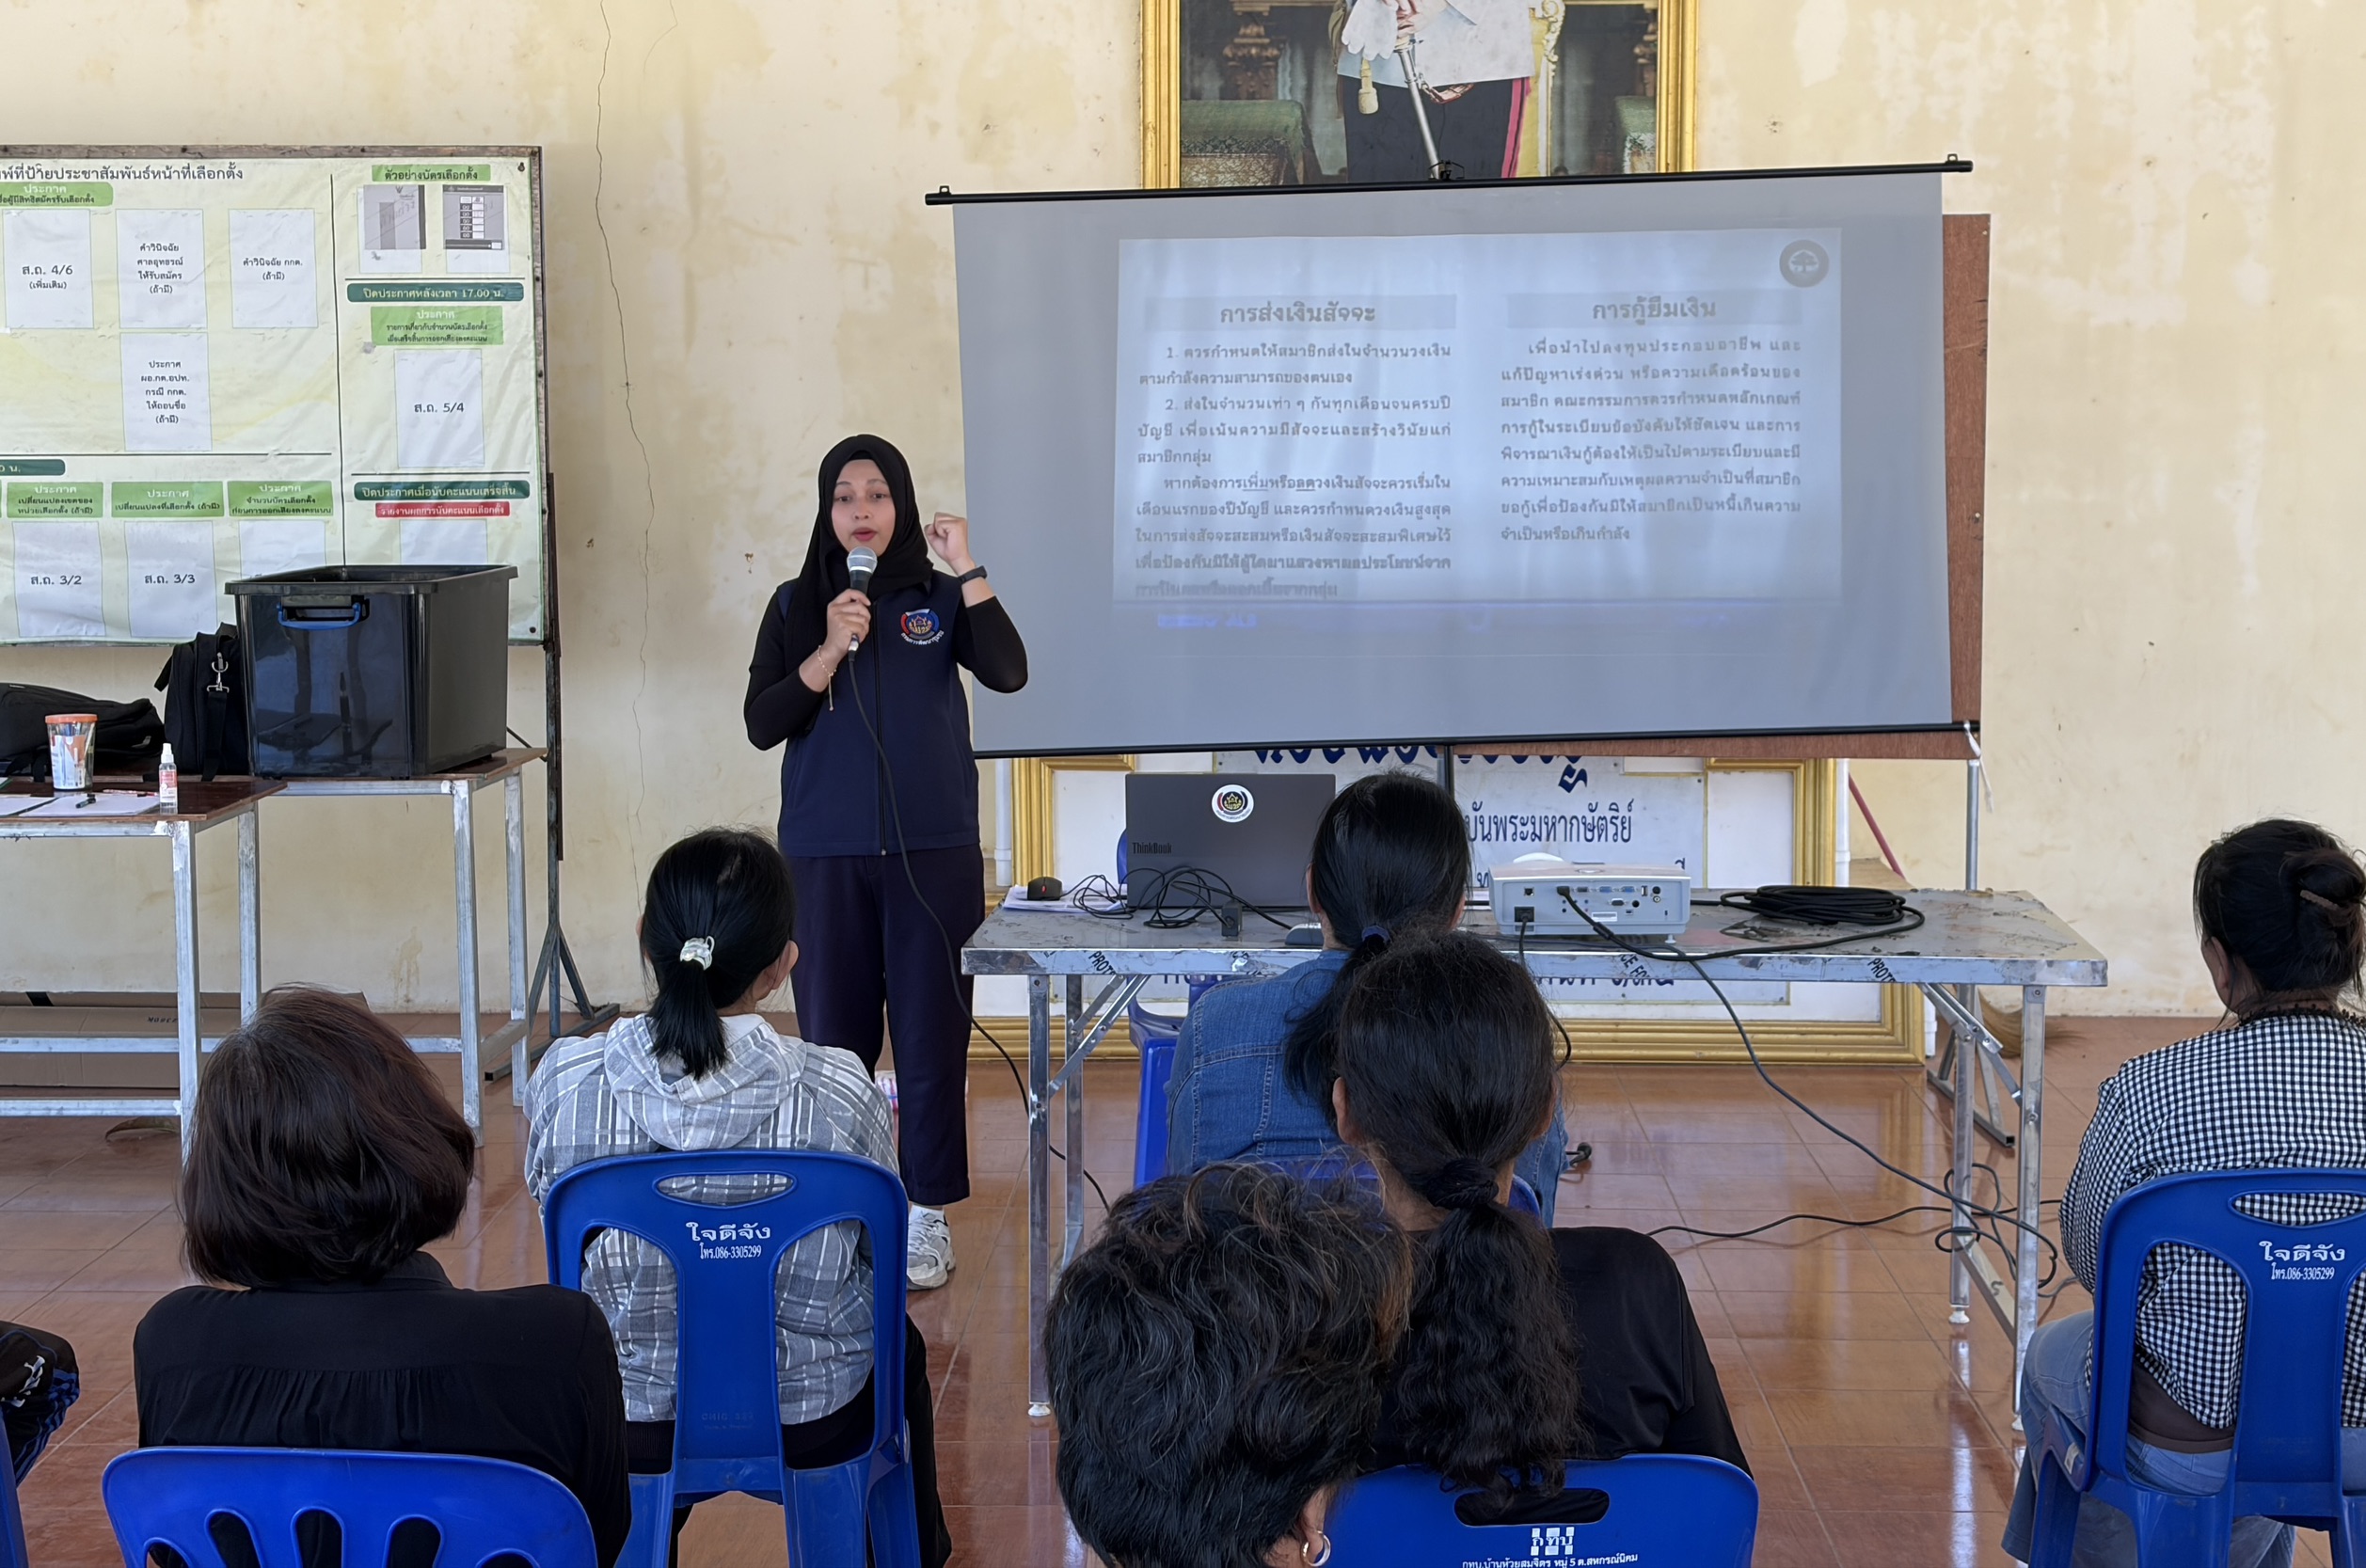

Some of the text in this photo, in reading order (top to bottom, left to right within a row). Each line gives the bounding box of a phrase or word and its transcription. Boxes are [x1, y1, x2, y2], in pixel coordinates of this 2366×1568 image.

[0, 162, 243, 180] พ์ที่ป้ายประชาสัมพันธ์หน้าที่เลือกตั้ง
[385, 166, 478, 181] ตัวอย่างบัตรเลือกตั้ง
[24, 183, 67, 194] ประกาศ
[139, 243, 180, 253] คำวินิจฉัย
[136, 256, 183, 267] ศาลอุทธรณ์
[243, 257, 303, 267] คำวินิจฉัย กกต.
[22, 264, 73, 276] ส.ถ. 4/6
[137, 271, 183, 280] ให้รับสมัคร
[262, 271, 285, 281] (ถ้ามี)
[29, 278, 67, 290] (เพิ่มเติม)
[150, 283, 173, 294] (ถ้ามี)
[363, 287, 504, 299] ปิดประกาศหลังเวลา 17.00 น.
[417, 309, 455, 320] ประกาศ
[1220, 300, 1376, 324] การส่งเงินสัจจะ
[1593, 295, 1717, 325] การกู้ยืมเงิน
[1166, 346, 1179, 358] 1.
[149, 359, 182, 369] ประกาศ
[145, 387, 187, 396] กรณี กกต.
[146, 401, 186, 410] ให้ถอนชื่อ
[1165, 398, 1179, 410] 2.
[1501, 393, 1549, 407] สมาชิก
[414, 403, 465, 413] ส.ถ. 5/4
[155, 414, 179, 424] (ถ้ามี)
[1137, 422, 1173, 440] บัญชี
[1137, 449, 1212, 467] สมาชิกกลุ่ม
[34, 484, 77, 494] ประกาศ
[147, 488, 189, 499] ประกาศ
[259, 483, 302, 493] ประกาศ
[362, 482, 516, 498] ปิดประกาศเมื่อนับคะแนนเสร็จสิ้น
[71, 506, 93, 515] (ถ้ามี)
[198, 501, 220, 512] (ถ้ามี)
[30, 575, 82, 585] ส.ถ. 3/2
[144, 574, 196, 584] ส.ถ. 3/3
[1132, 842, 1172, 855] ThinkBook
[685, 1221, 771, 1242] ใจดีจัง
[699, 1242, 762, 1260] โทร.086-3305299
[2259, 1240, 2345, 1261] ใจดีจัง
[2271, 1261, 2335, 1280] โทร.086-3305299
[1569, 1558, 1576, 1566] 5
[1578, 1552, 1639, 1566] ต.สหกรณ์นิคม
